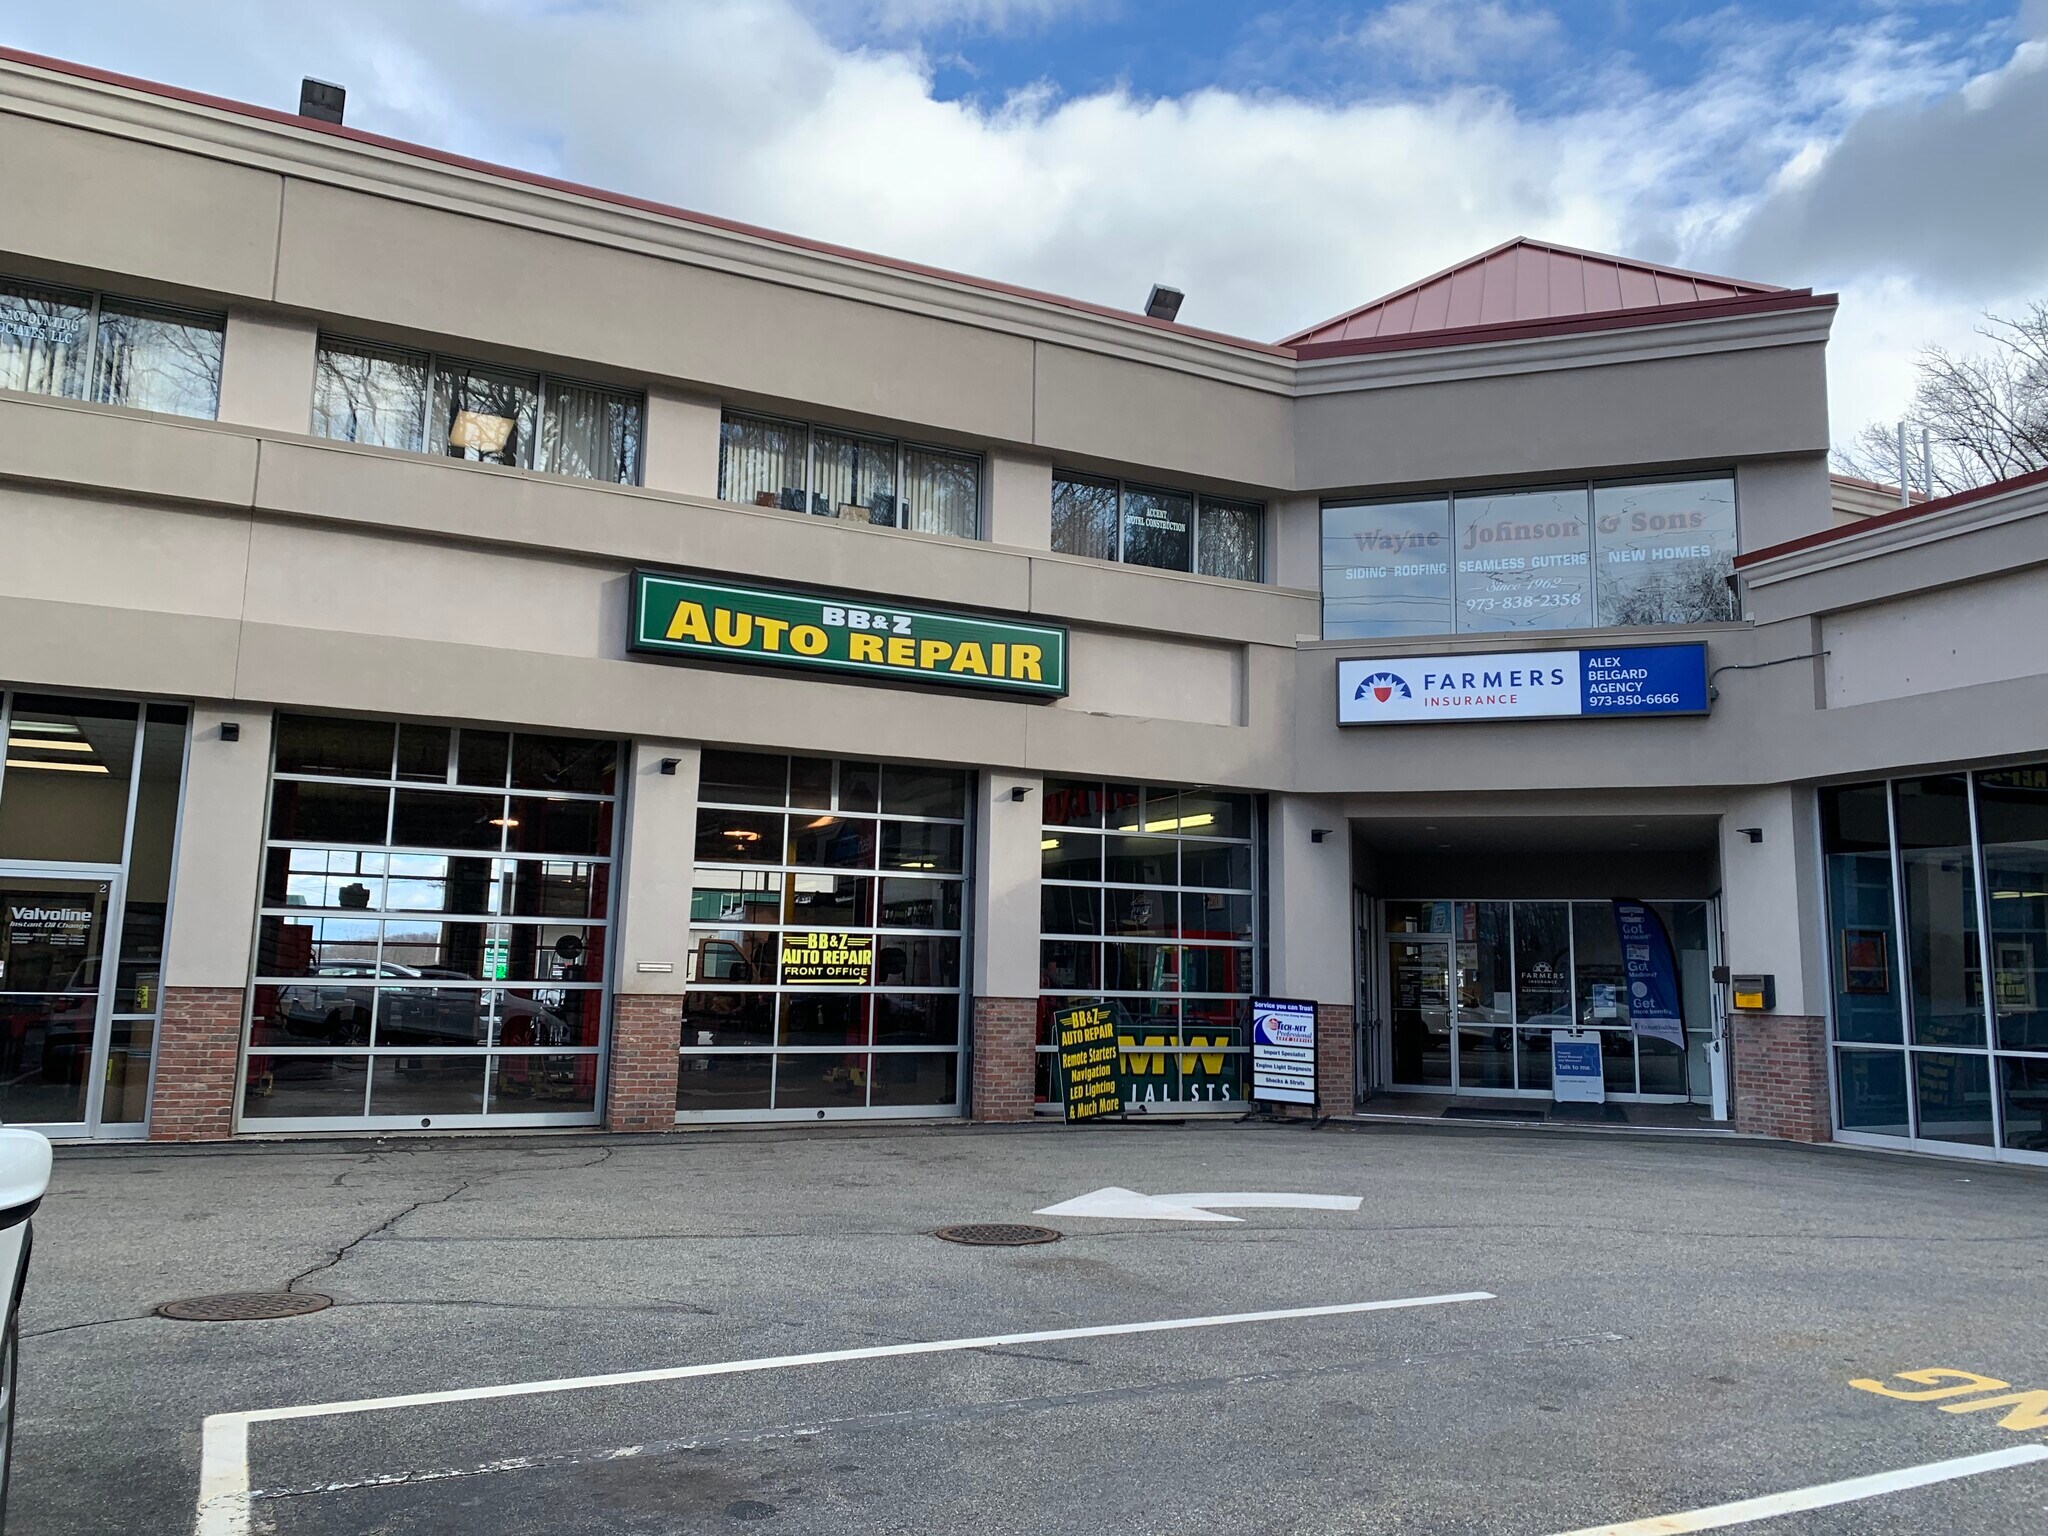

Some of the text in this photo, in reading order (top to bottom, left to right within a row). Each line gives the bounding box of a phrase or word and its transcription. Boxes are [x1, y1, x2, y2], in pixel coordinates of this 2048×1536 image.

[5, 309, 79, 332] ACCOUNTING
[51, 330, 73, 344] LLC
[1146, 508, 1168, 519] ACCENT
[1145, 518, 1186, 532] CONSTRUCTION
[1354, 512, 1703, 554] Wayne Johnson & Sons
[1346, 545, 1712, 580] SIDING ROOFING SEAMLESS GUTTERS NEW HOMES
[1486, 577, 1562, 593] Since 1962
[1466, 592, 1582, 611] 973-838-2358
[822, 606, 912, 635] BB&Z
[664, 600, 1042, 681] AUTO REPAIR
[1588, 657, 1621, 669] ALEX
[1424, 668, 1565, 691] FARMERS
[1588, 669, 1648, 681] BELGARD
[1589, 682, 1644, 694] AGENCY
[1424, 694, 1518, 707] INSURANCE
[1589, 693, 1680, 707] 973-850-6666
[99, 884, 107, 893] 2
[11, 906, 92, 922] Valvoline
[56, 922, 91, 930] Change
[1623, 924, 1644, 934] Got
[808, 933, 848, 949] BB&Z
[782, 948, 872, 965] AUTO REPAIR
[785, 967, 868, 976] FRONT OFFICE
[1628, 961, 1649, 972] Got
[1254, 1001, 1275, 1009] Service
[1298, 1004, 1313, 1012] Trust
[1633, 998, 1656, 1008] Get
[1071, 1008, 1100, 1029] BB&Z
[1062, 1023, 1114, 1047] AUTO REPAIR
[1063, 1046, 1117, 1069] Remote Starters
[1281, 1050, 1306, 1058] Specialist
[1071, 1064, 1111, 1083] Navigation
[1273, 1063, 1287, 1071] Light
[1287, 1065, 1312, 1073] Diagnosis
[1070, 1080, 1116, 1100] LED Lighting
[1069, 1098, 1119, 1120] & Much More
